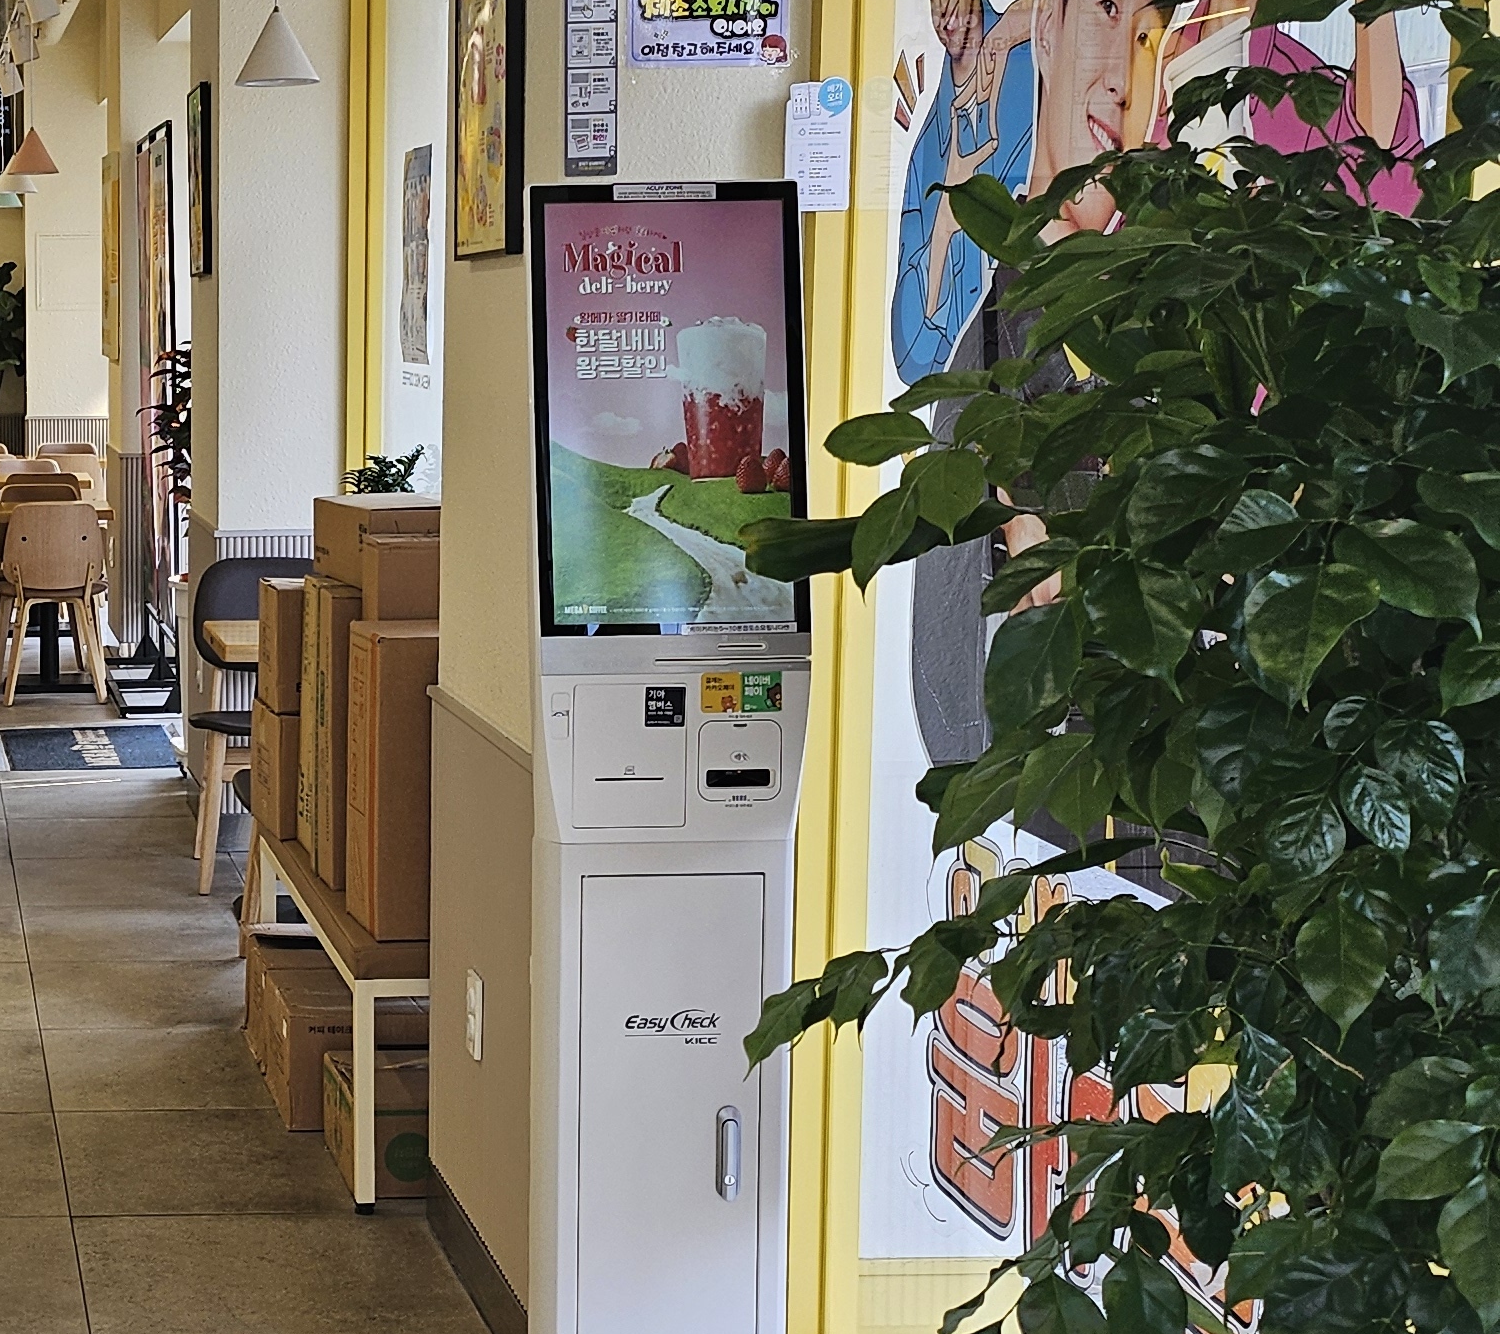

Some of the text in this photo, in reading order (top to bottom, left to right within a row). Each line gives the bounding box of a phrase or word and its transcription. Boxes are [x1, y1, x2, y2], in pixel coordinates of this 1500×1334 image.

[609, 9, 616, 21] 3
[609, 100, 616, 112] 5
[563, 240, 684, 279] Magical
[578, 274, 673, 295] deli-berry
[575, 328, 666, 353] 한달내내
[576, 355, 667, 380] 왕큰할인
[744, 674, 771, 685] 네이버
[648, 689, 666, 699] 기아
[308, 1025, 325, 1034] 커피
